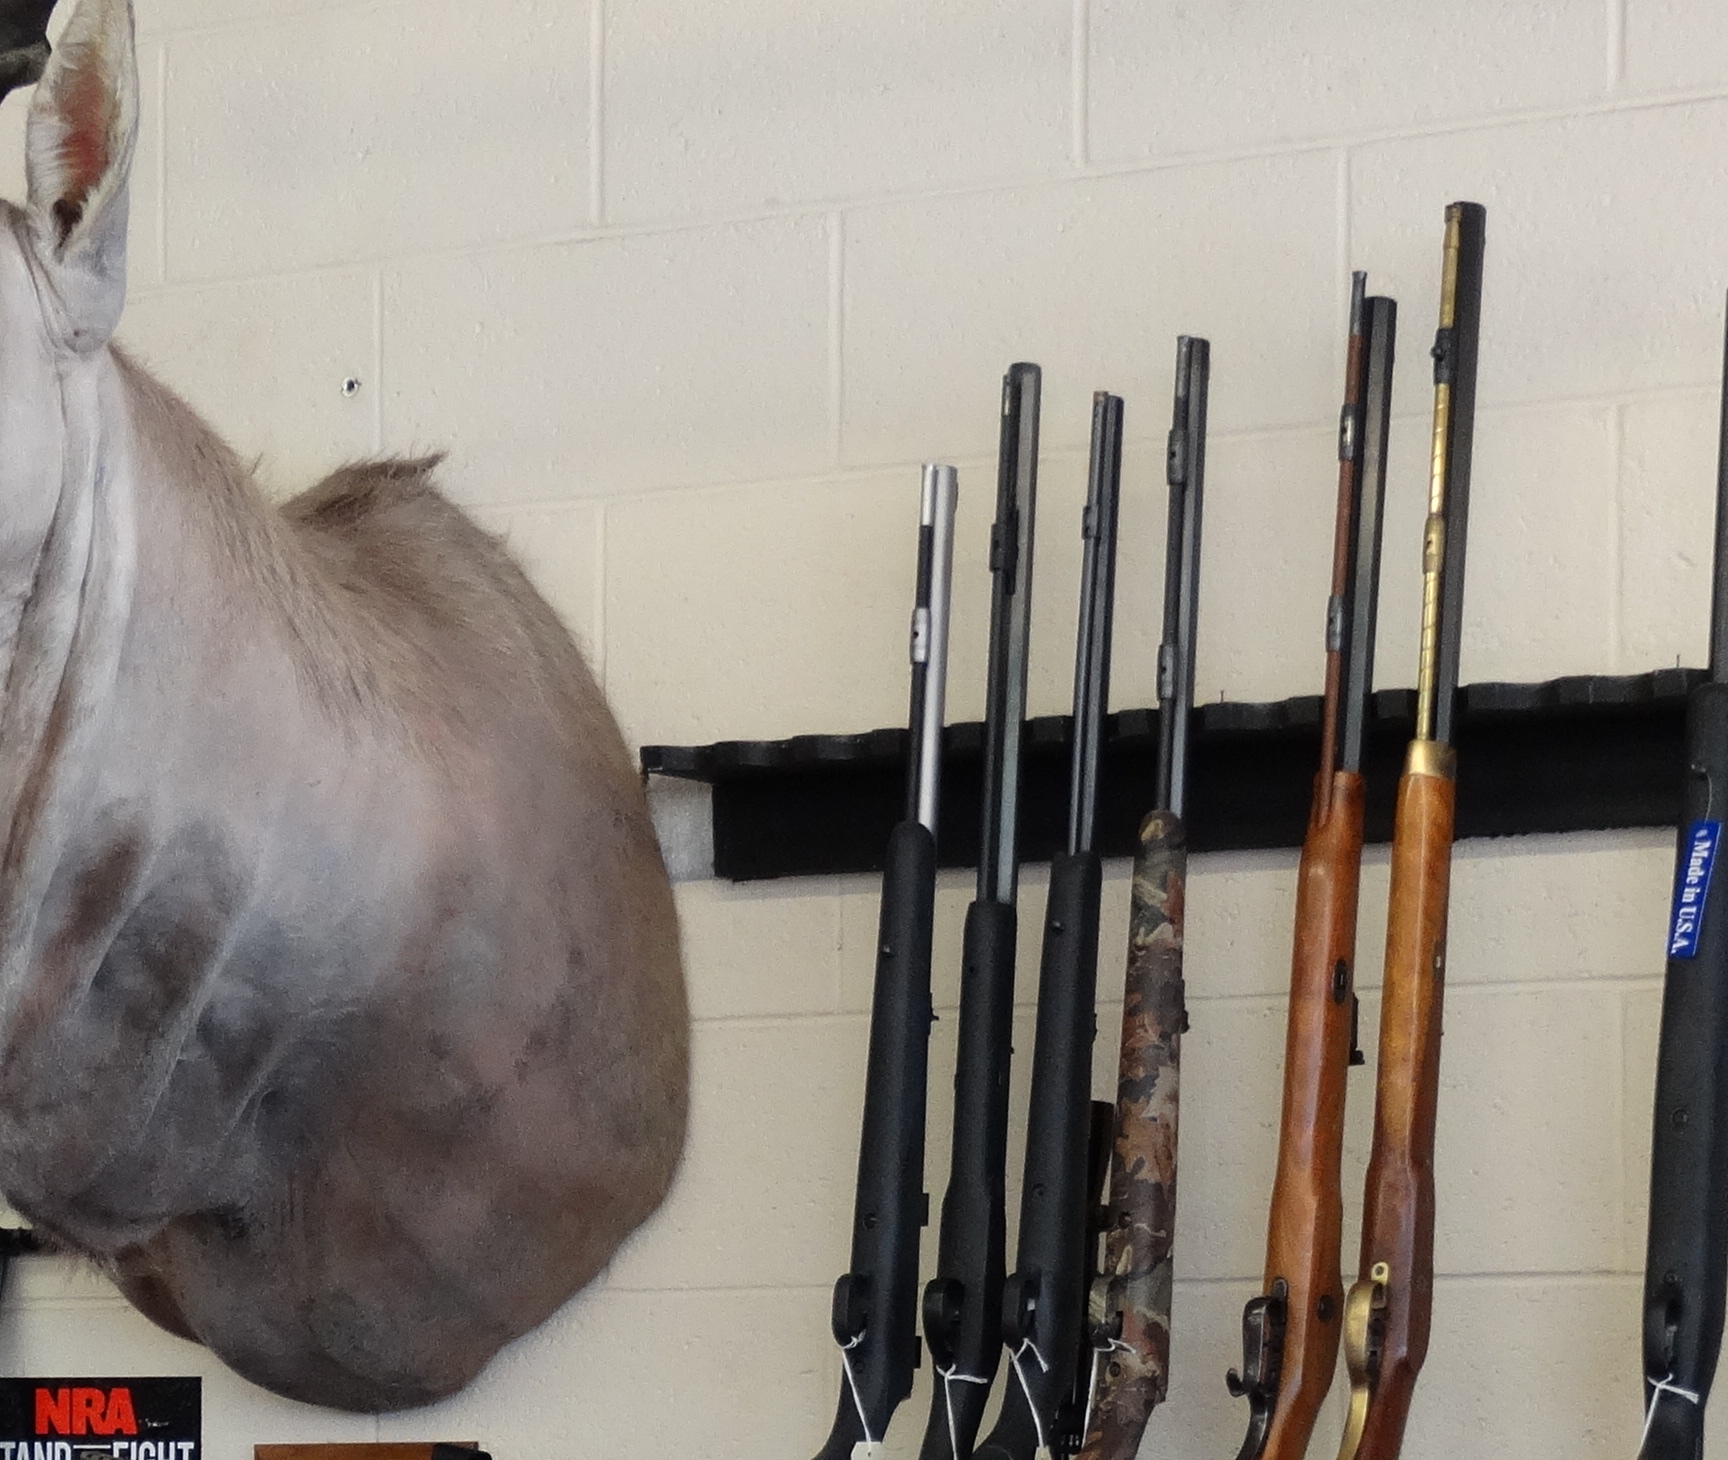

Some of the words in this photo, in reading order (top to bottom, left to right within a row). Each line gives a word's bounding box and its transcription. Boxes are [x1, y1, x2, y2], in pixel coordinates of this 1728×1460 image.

[1686, 839, 1712, 885] Made
[1682, 885, 1700, 903] in
[1670, 906, 1697, 954] U.S.A.
[35, 1387, 138, 1435] NRA
